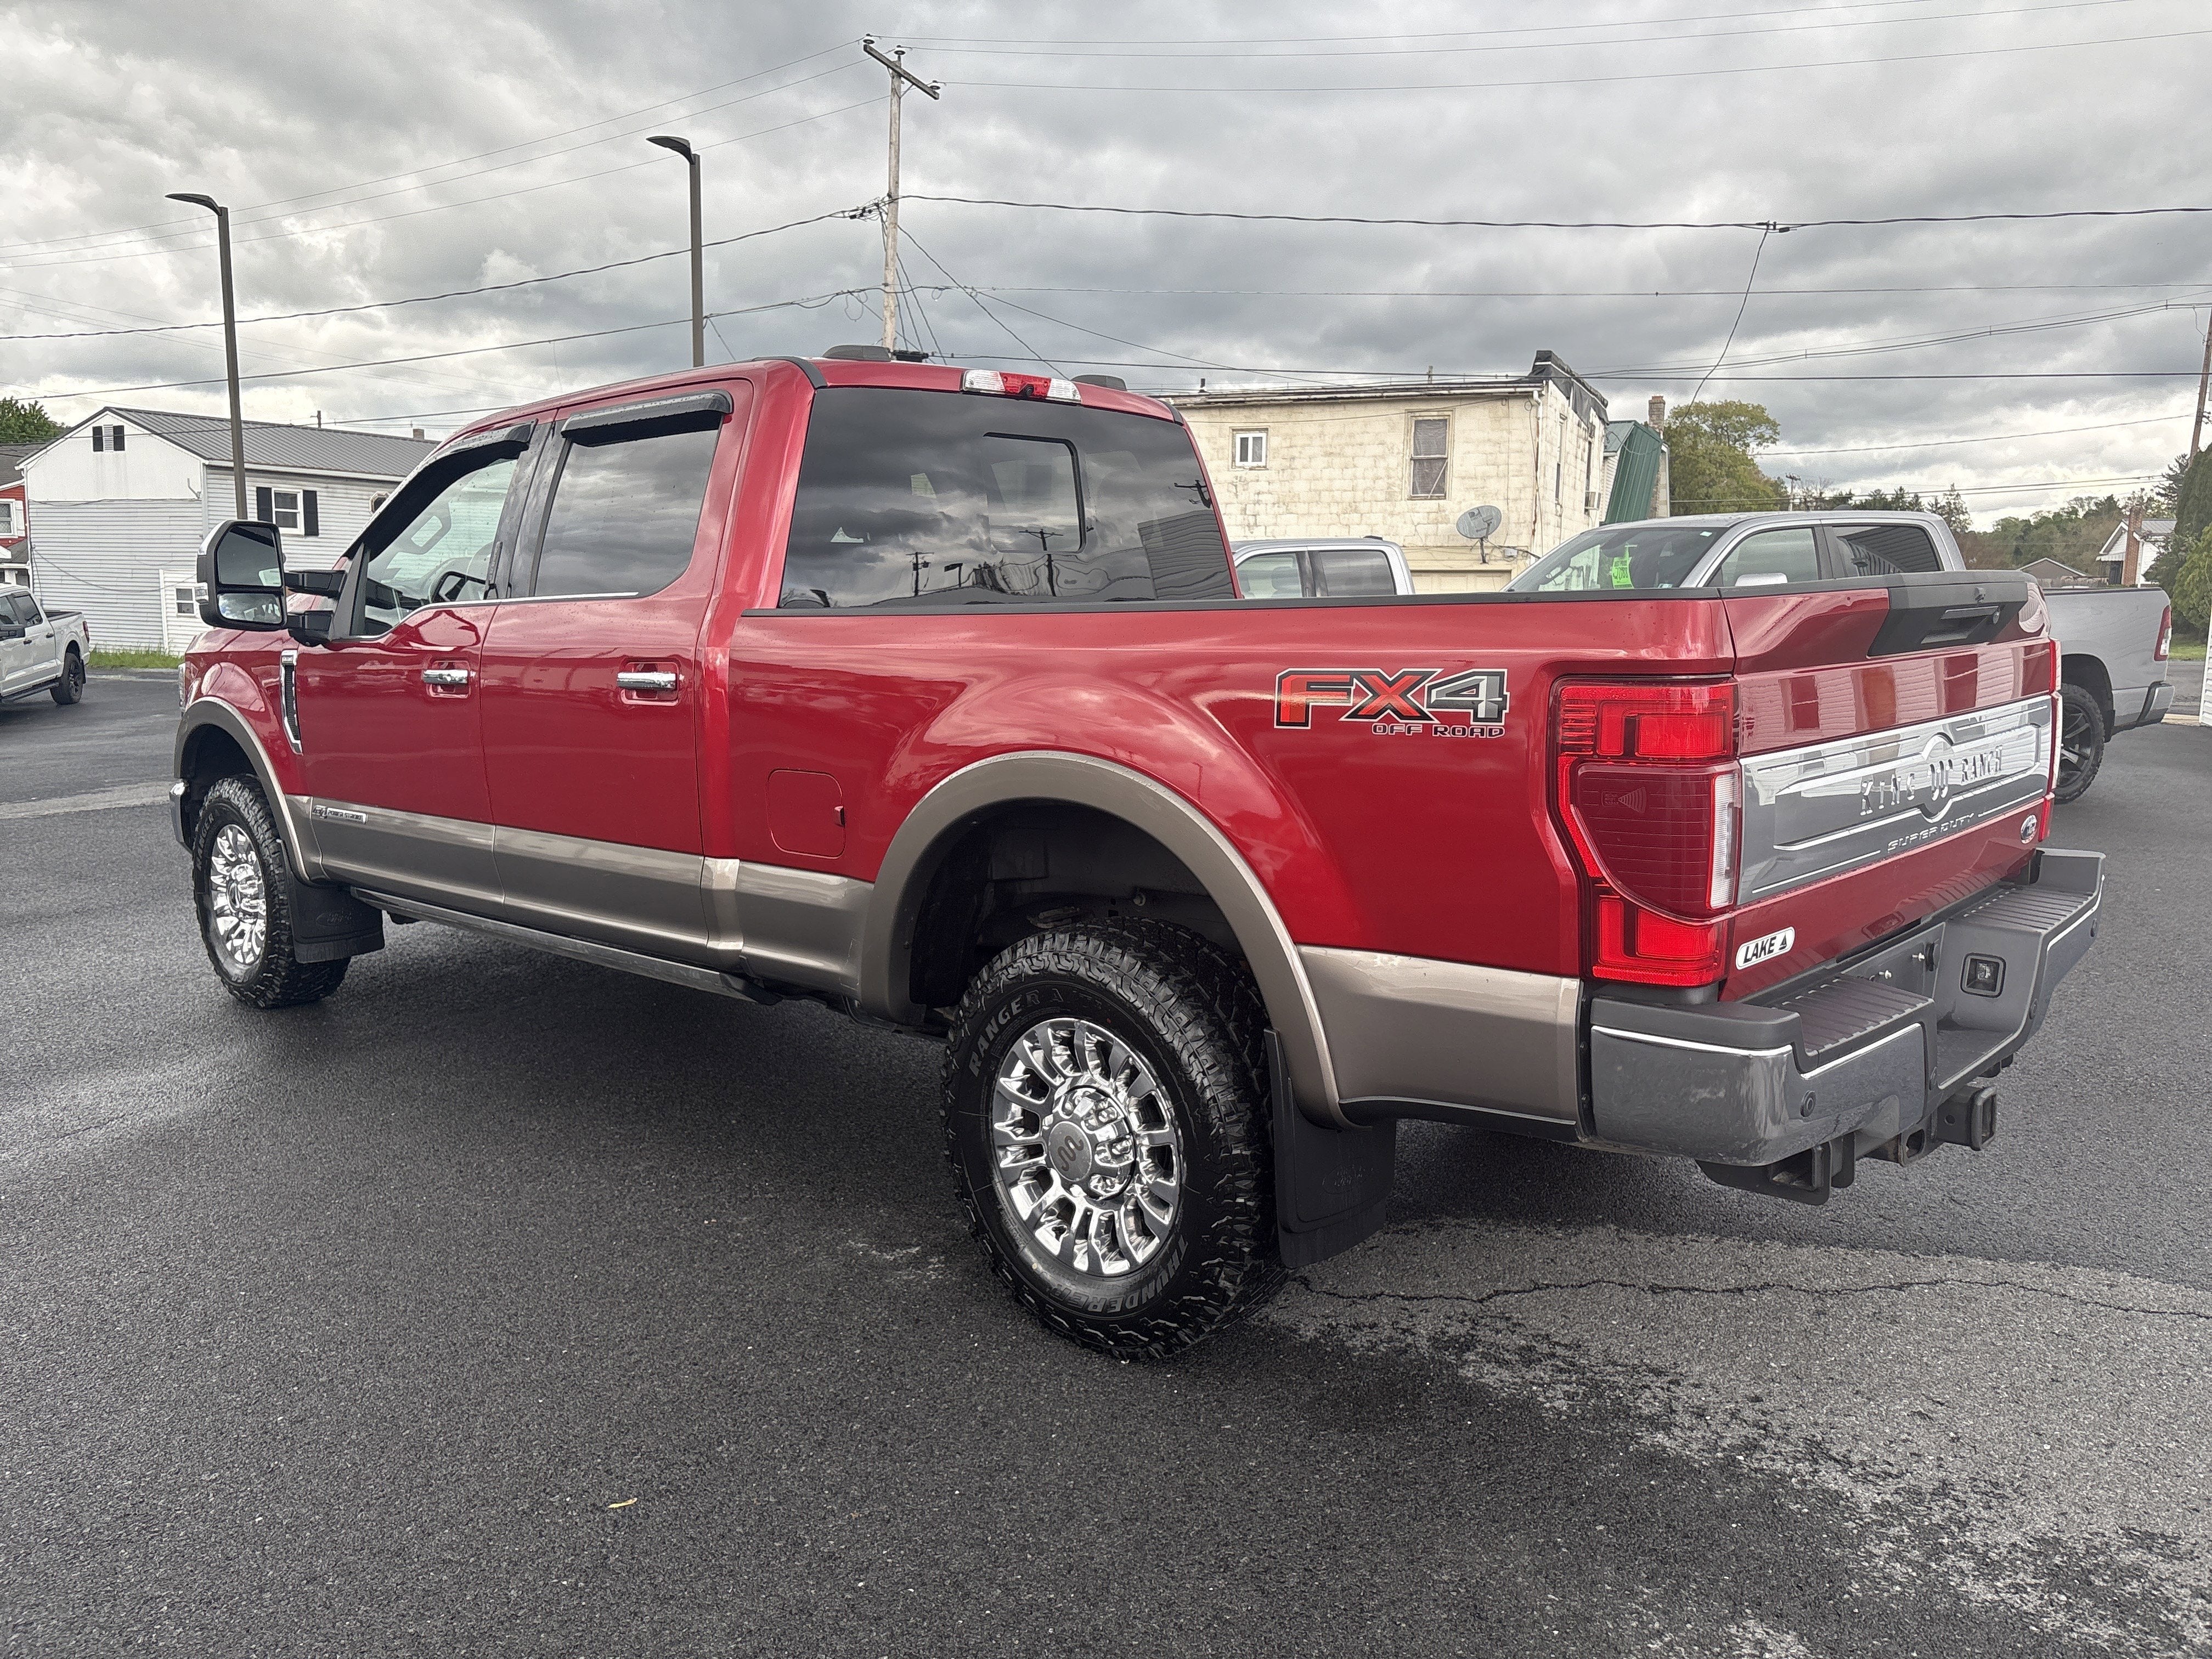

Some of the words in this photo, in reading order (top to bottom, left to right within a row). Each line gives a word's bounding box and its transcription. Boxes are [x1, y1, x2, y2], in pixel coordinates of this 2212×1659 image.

[1274, 668, 1510, 729] FX4
[1372, 723, 1423, 736] OFF
[1432, 724, 1505, 738] ROAD
[1860, 773, 1915, 816] KING
[1961, 744, 2003, 786] RANCH
[1887, 826, 1938, 853] SUPER
[1940, 812, 1974, 833] DUTY
[1742, 935, 1777, 964] LAKE
[969, 989, 1040, 1077] RANGER
[1049, 1234, 1189, 1313] THUNDERER
